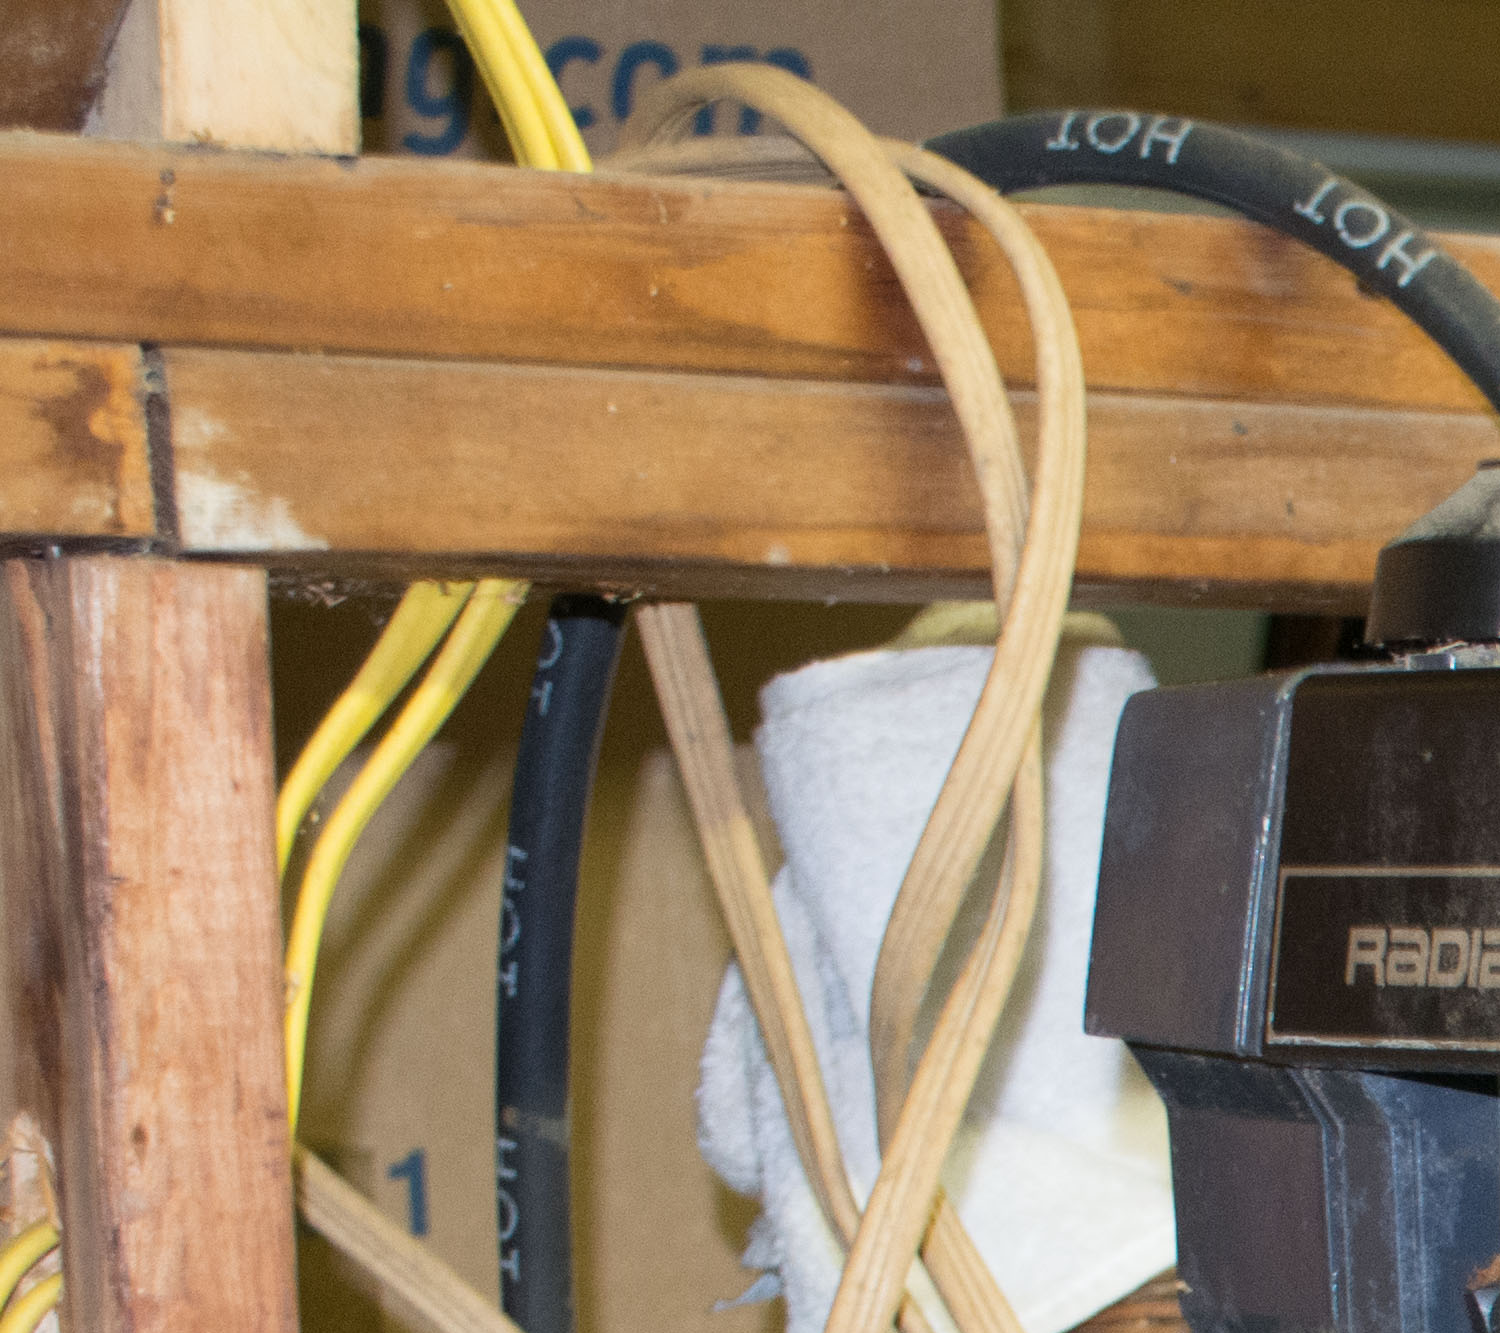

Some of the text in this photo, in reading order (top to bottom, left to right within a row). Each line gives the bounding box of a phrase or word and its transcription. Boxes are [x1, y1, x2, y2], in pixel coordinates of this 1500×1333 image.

[1046, 110, 1193, 164] HOT
[1294, 179, 1438, 287] HOT
[387, 1146, 429, 1236] 1
